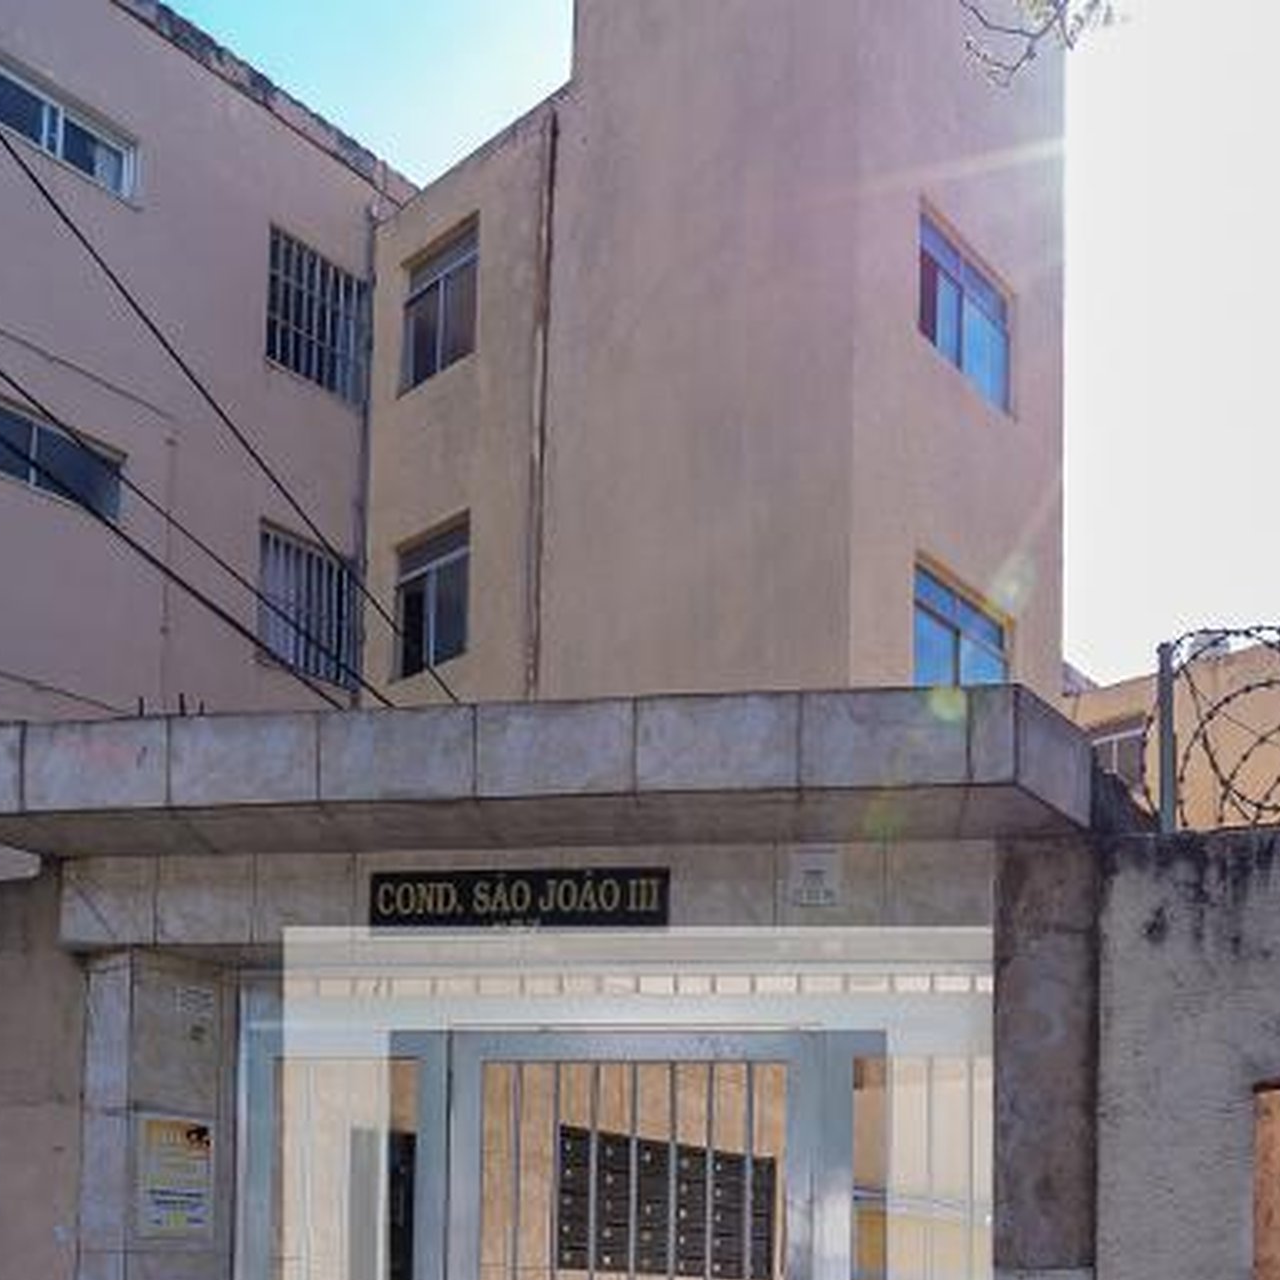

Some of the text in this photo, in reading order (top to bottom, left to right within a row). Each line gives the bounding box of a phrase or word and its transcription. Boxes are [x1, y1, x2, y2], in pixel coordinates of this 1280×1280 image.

[376, 869, 661, 916] COND. SÃO JOÃO III
